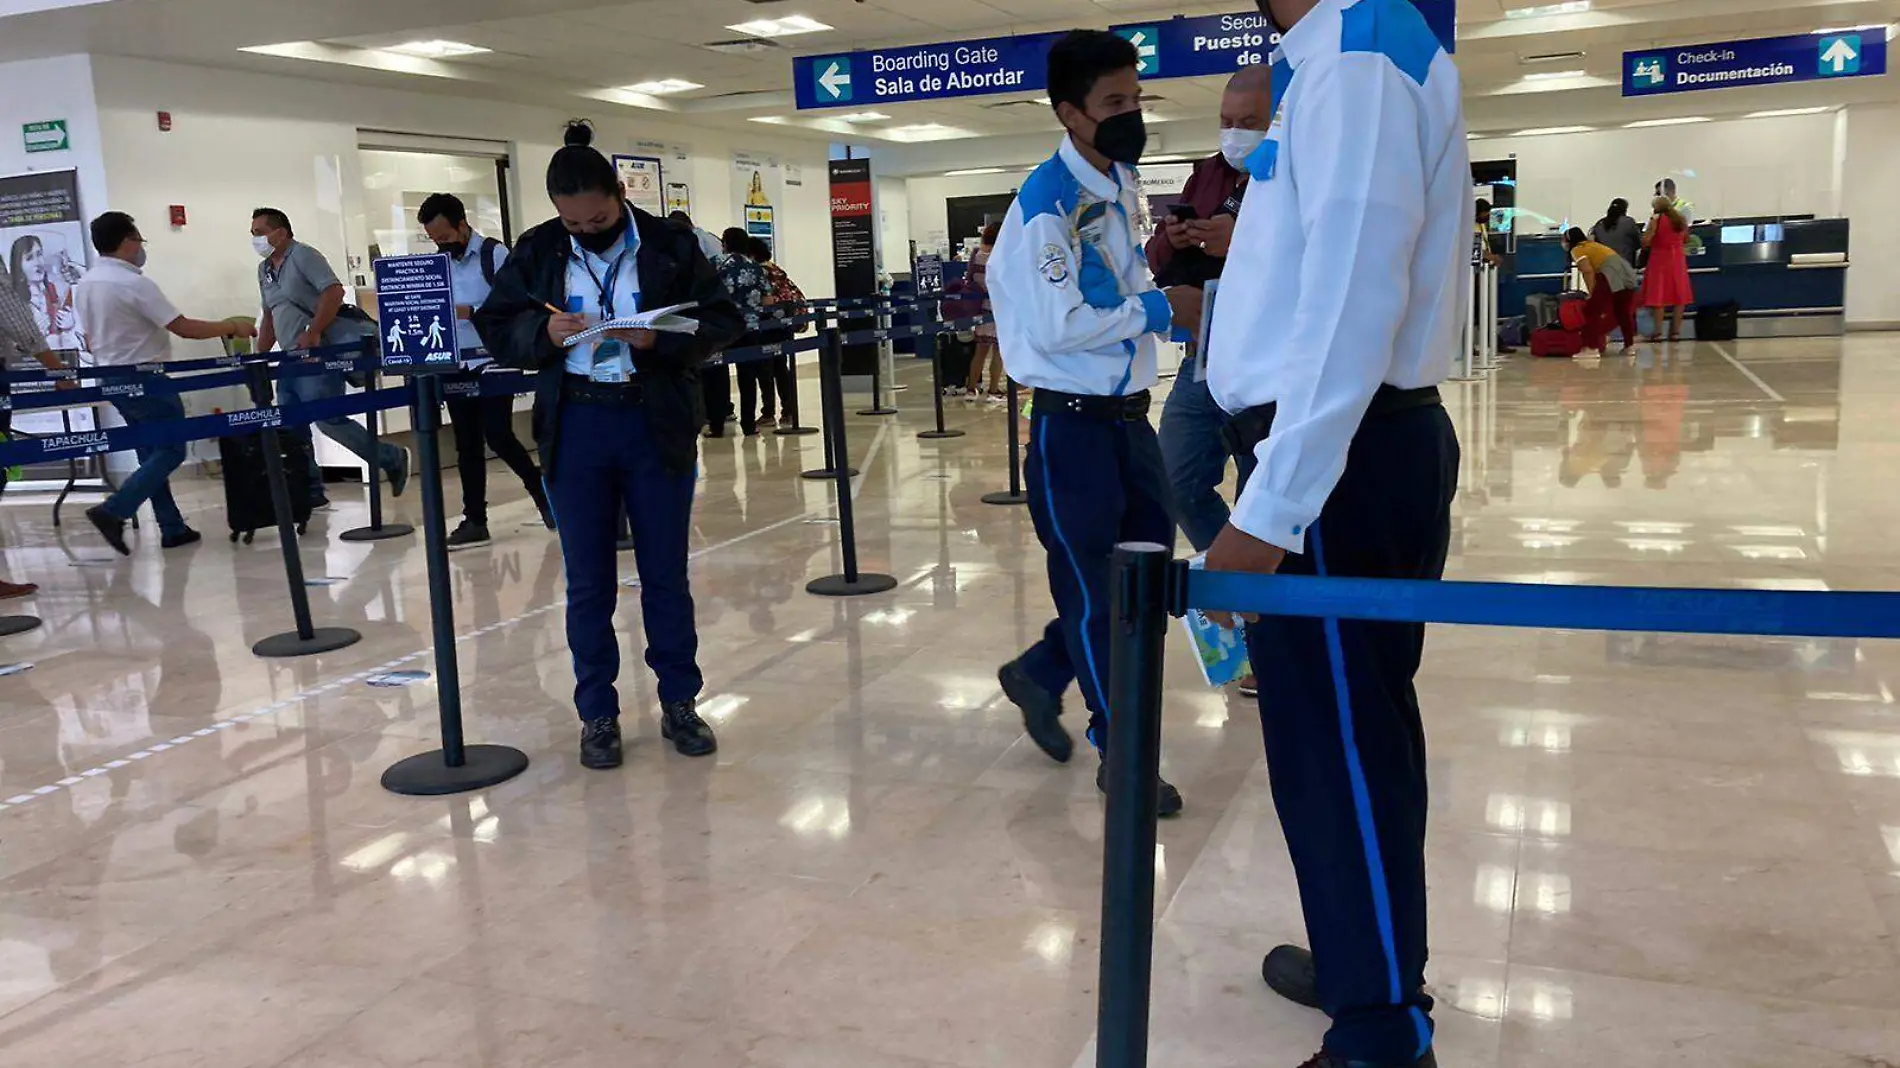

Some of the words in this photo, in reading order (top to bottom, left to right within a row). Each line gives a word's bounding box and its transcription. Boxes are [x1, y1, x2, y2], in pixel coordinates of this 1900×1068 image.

[1194, 33, 1263, 51] Puesto
[872, 50, 950, 72] Boarding
[955, 46, 998, 64] Gate
[1236, 50, 1262, 65] de
[1677, 50, 1736, 64] Check-in
[1676, 62, 1794, 84] Documentación
[875, 76, 914, 96] Sala
[919, 74, 942, 92] de
[946, 68, 1024, 90] Abordar
[831, 202, 870, 211] PRIORITY
[425, 352, 452, 362] ASUR
[101, 384, 144, 394] TAPACHULA
[228, 408, 280, 423] TAPACHULA
[41, 432, 108, 448] TAPACHULA
